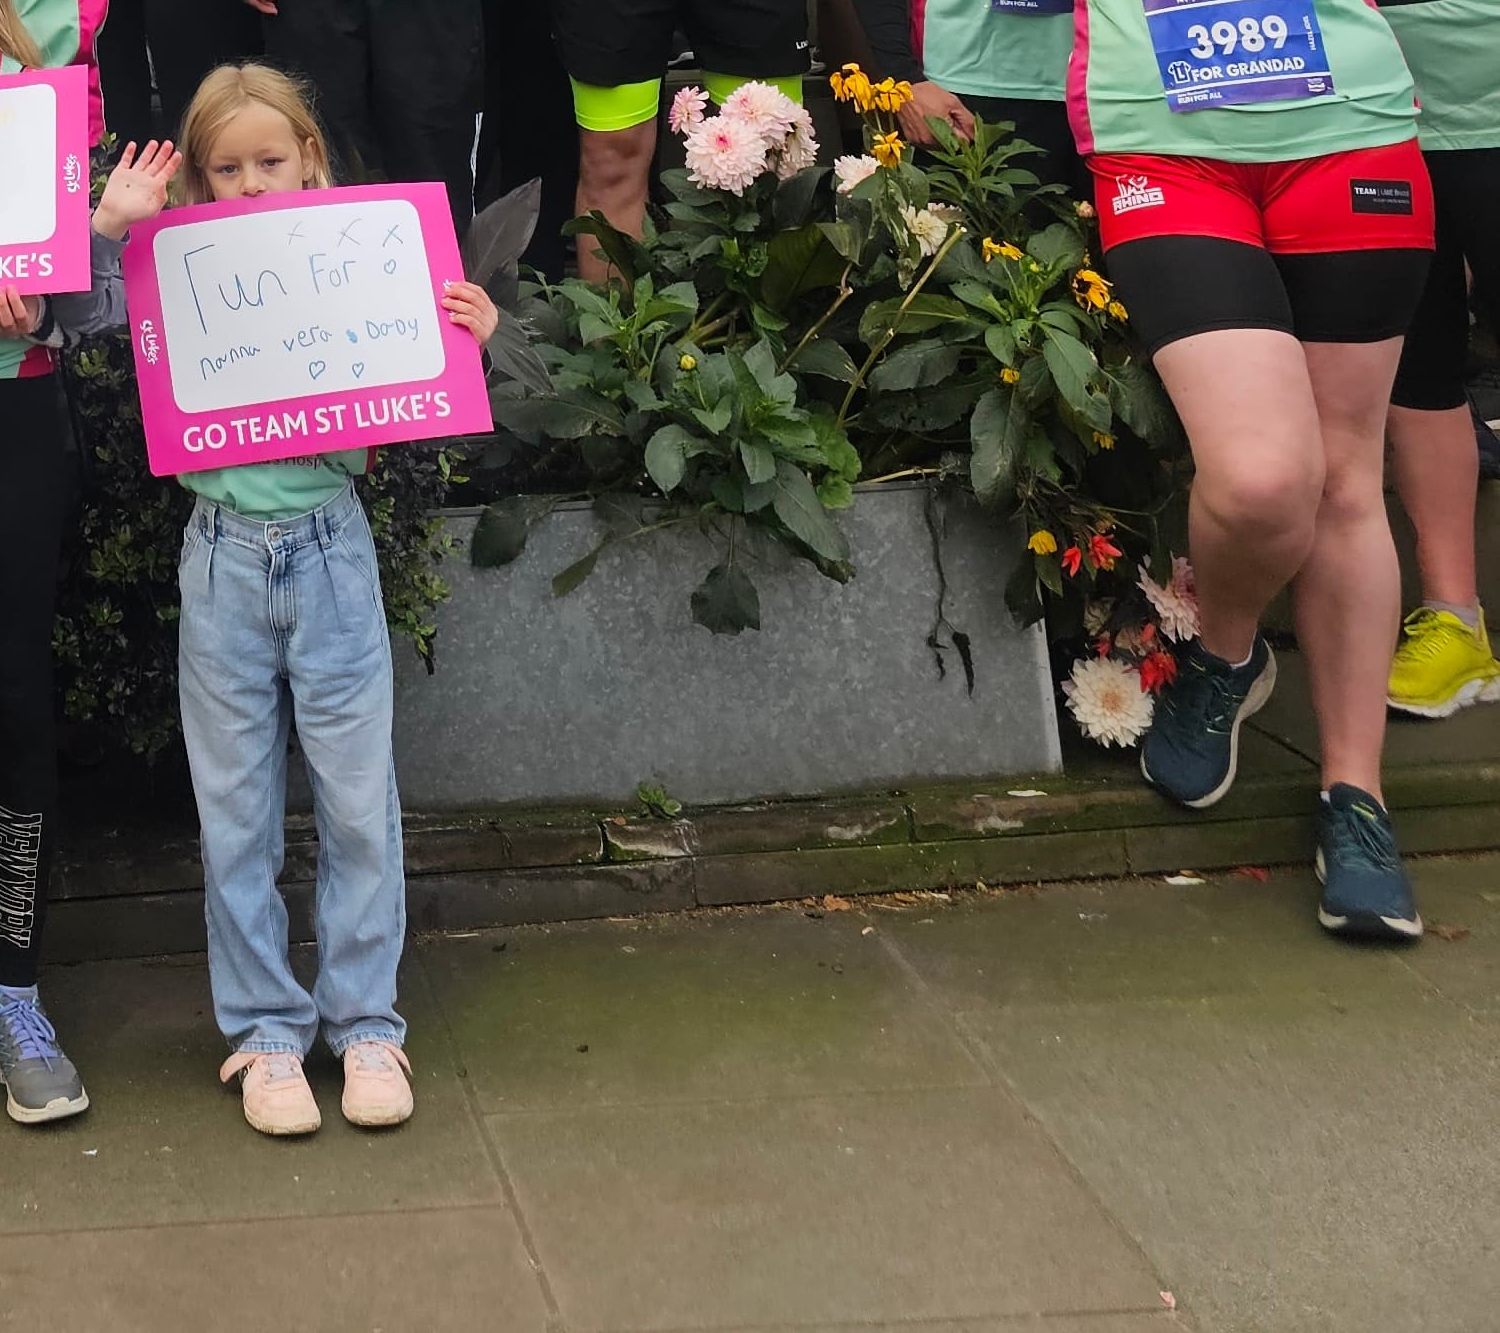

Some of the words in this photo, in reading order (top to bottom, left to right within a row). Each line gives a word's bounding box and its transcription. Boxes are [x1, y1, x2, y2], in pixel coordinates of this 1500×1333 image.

[1187, 15, 1288, 60] 3989
[1191, 65, 1223, 82] FOR
[1226, 56, 1305, 77] GRANDAD
[1112, 190, 1165, 213] RHINO
[1354, 187, 1376, 195] TEAM
[200, 346, 261, 381] nanna
[283, 327, 333, 352] vera
[183, 424, 227, 453] GO
[230, 412, 309, 443] TEAM
[314, 405, 348, 435] ST
[354, 391, 451, 427] LUKE'S
